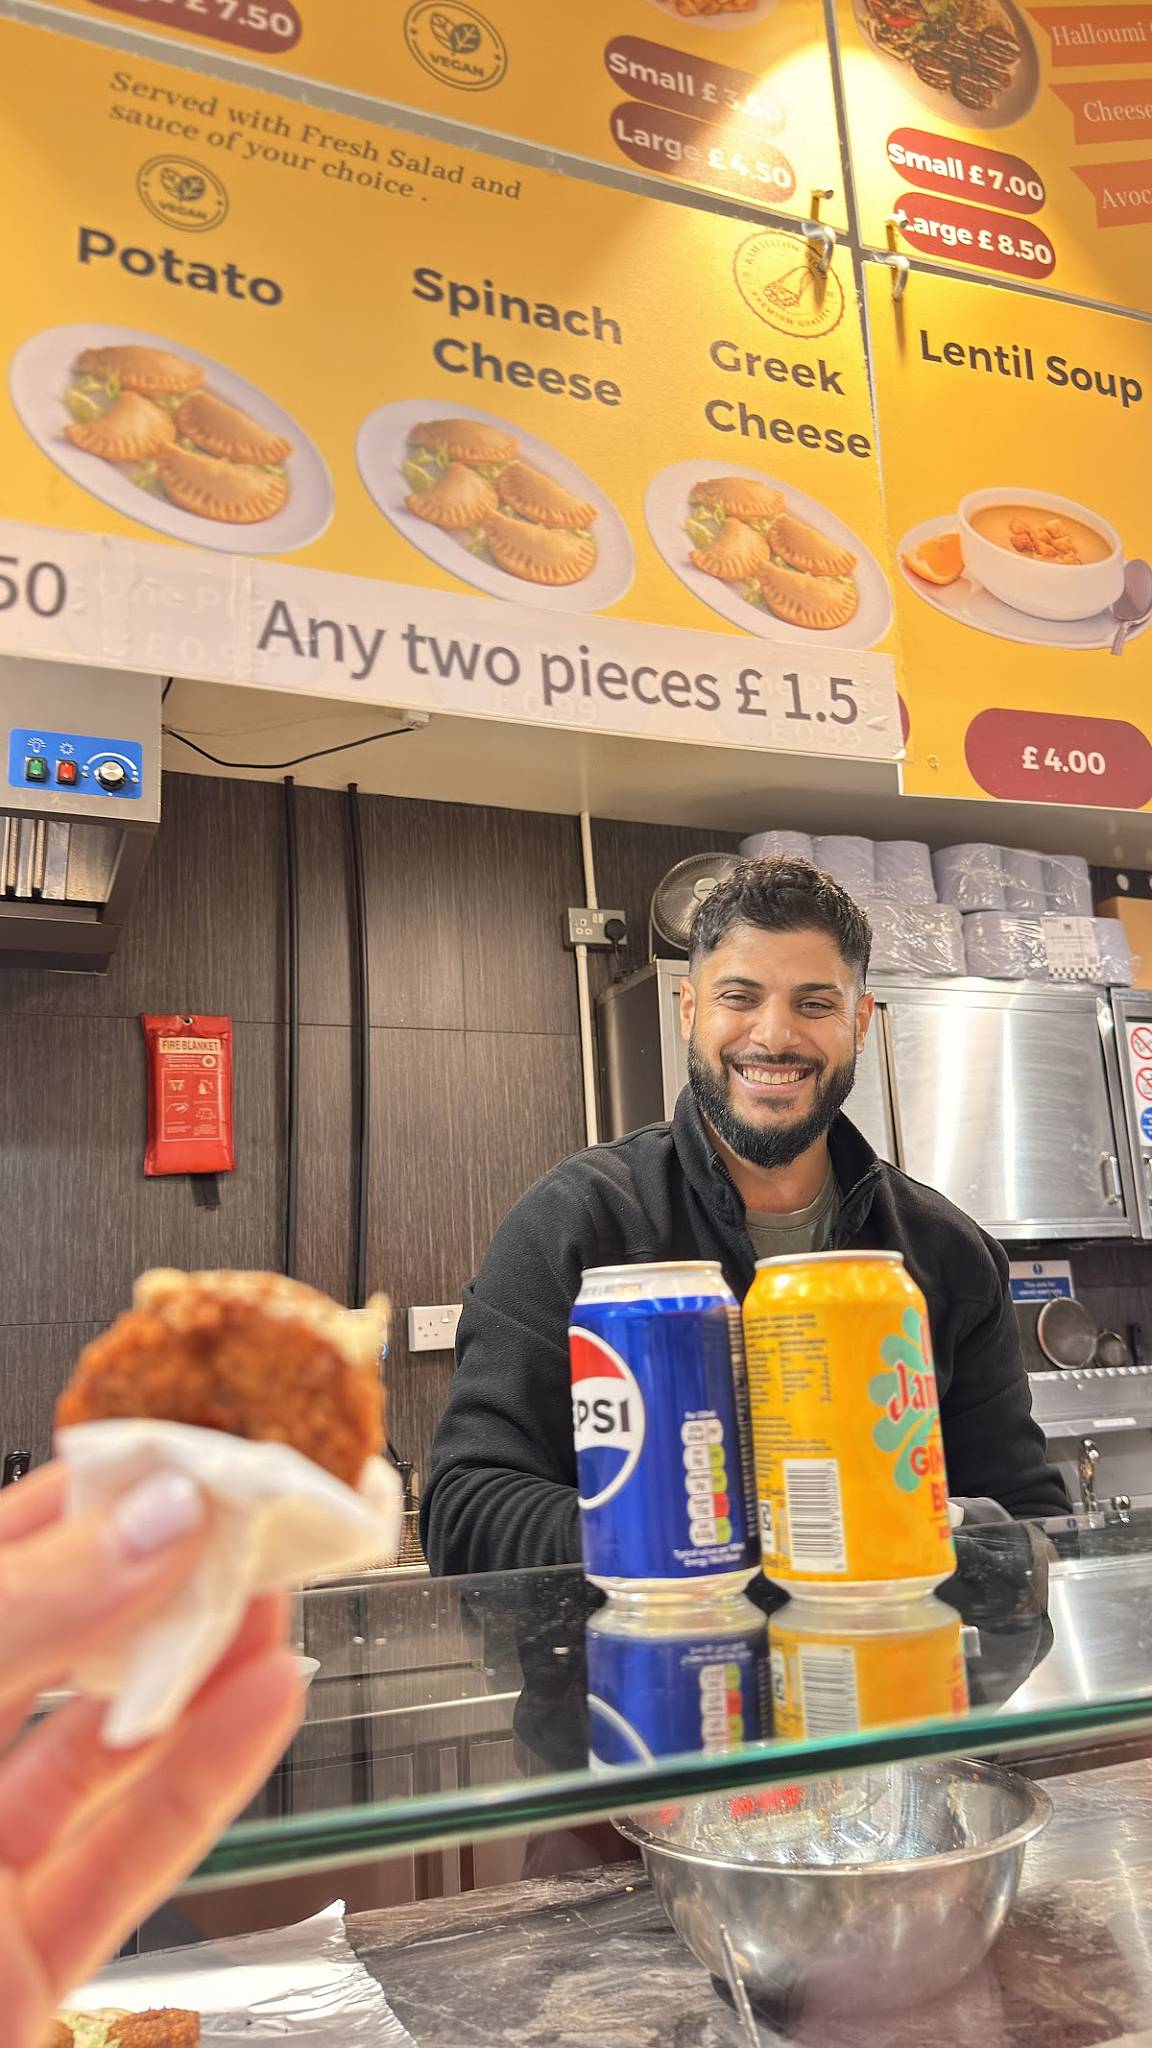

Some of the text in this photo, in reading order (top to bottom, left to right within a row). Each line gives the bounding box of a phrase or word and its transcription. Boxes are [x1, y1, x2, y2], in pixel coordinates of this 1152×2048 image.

[1052, 21, 1147, 46] Halloumi
[429, 52, 484, 77] VEGAN
[608, 52, 695, 97] Small
[109, 71, 521, 201] Served with Fresh Salad and
[1083, 99, 1152, 122] Cheese
[109, 102, 199, 142] sauce
[207, 128, 244, 152] of
[242, 140, 315, 174] your
[615, 119, 700, 162] Large
[886, 142, 964, 181] Small
[159, 200, 208, 219] VEGAN
[898, 208, 973, 246] Large
[76, 226, 284, 307] Potato
[411, 266, 623, 345] Spinach
[433, 338, 623, 407] Cheese
[710, 339, 846, 396] Greek
[919, 329, 1143, 408] Lentil Soup
[704, 399, 872, 458] Cheese
[257, 599, 386, 680] Any
[400, 623, 521, 687] two
[540, 644, 721, 711] pieces
[162, 1040, 218, 1051] FIRE BLANKET
